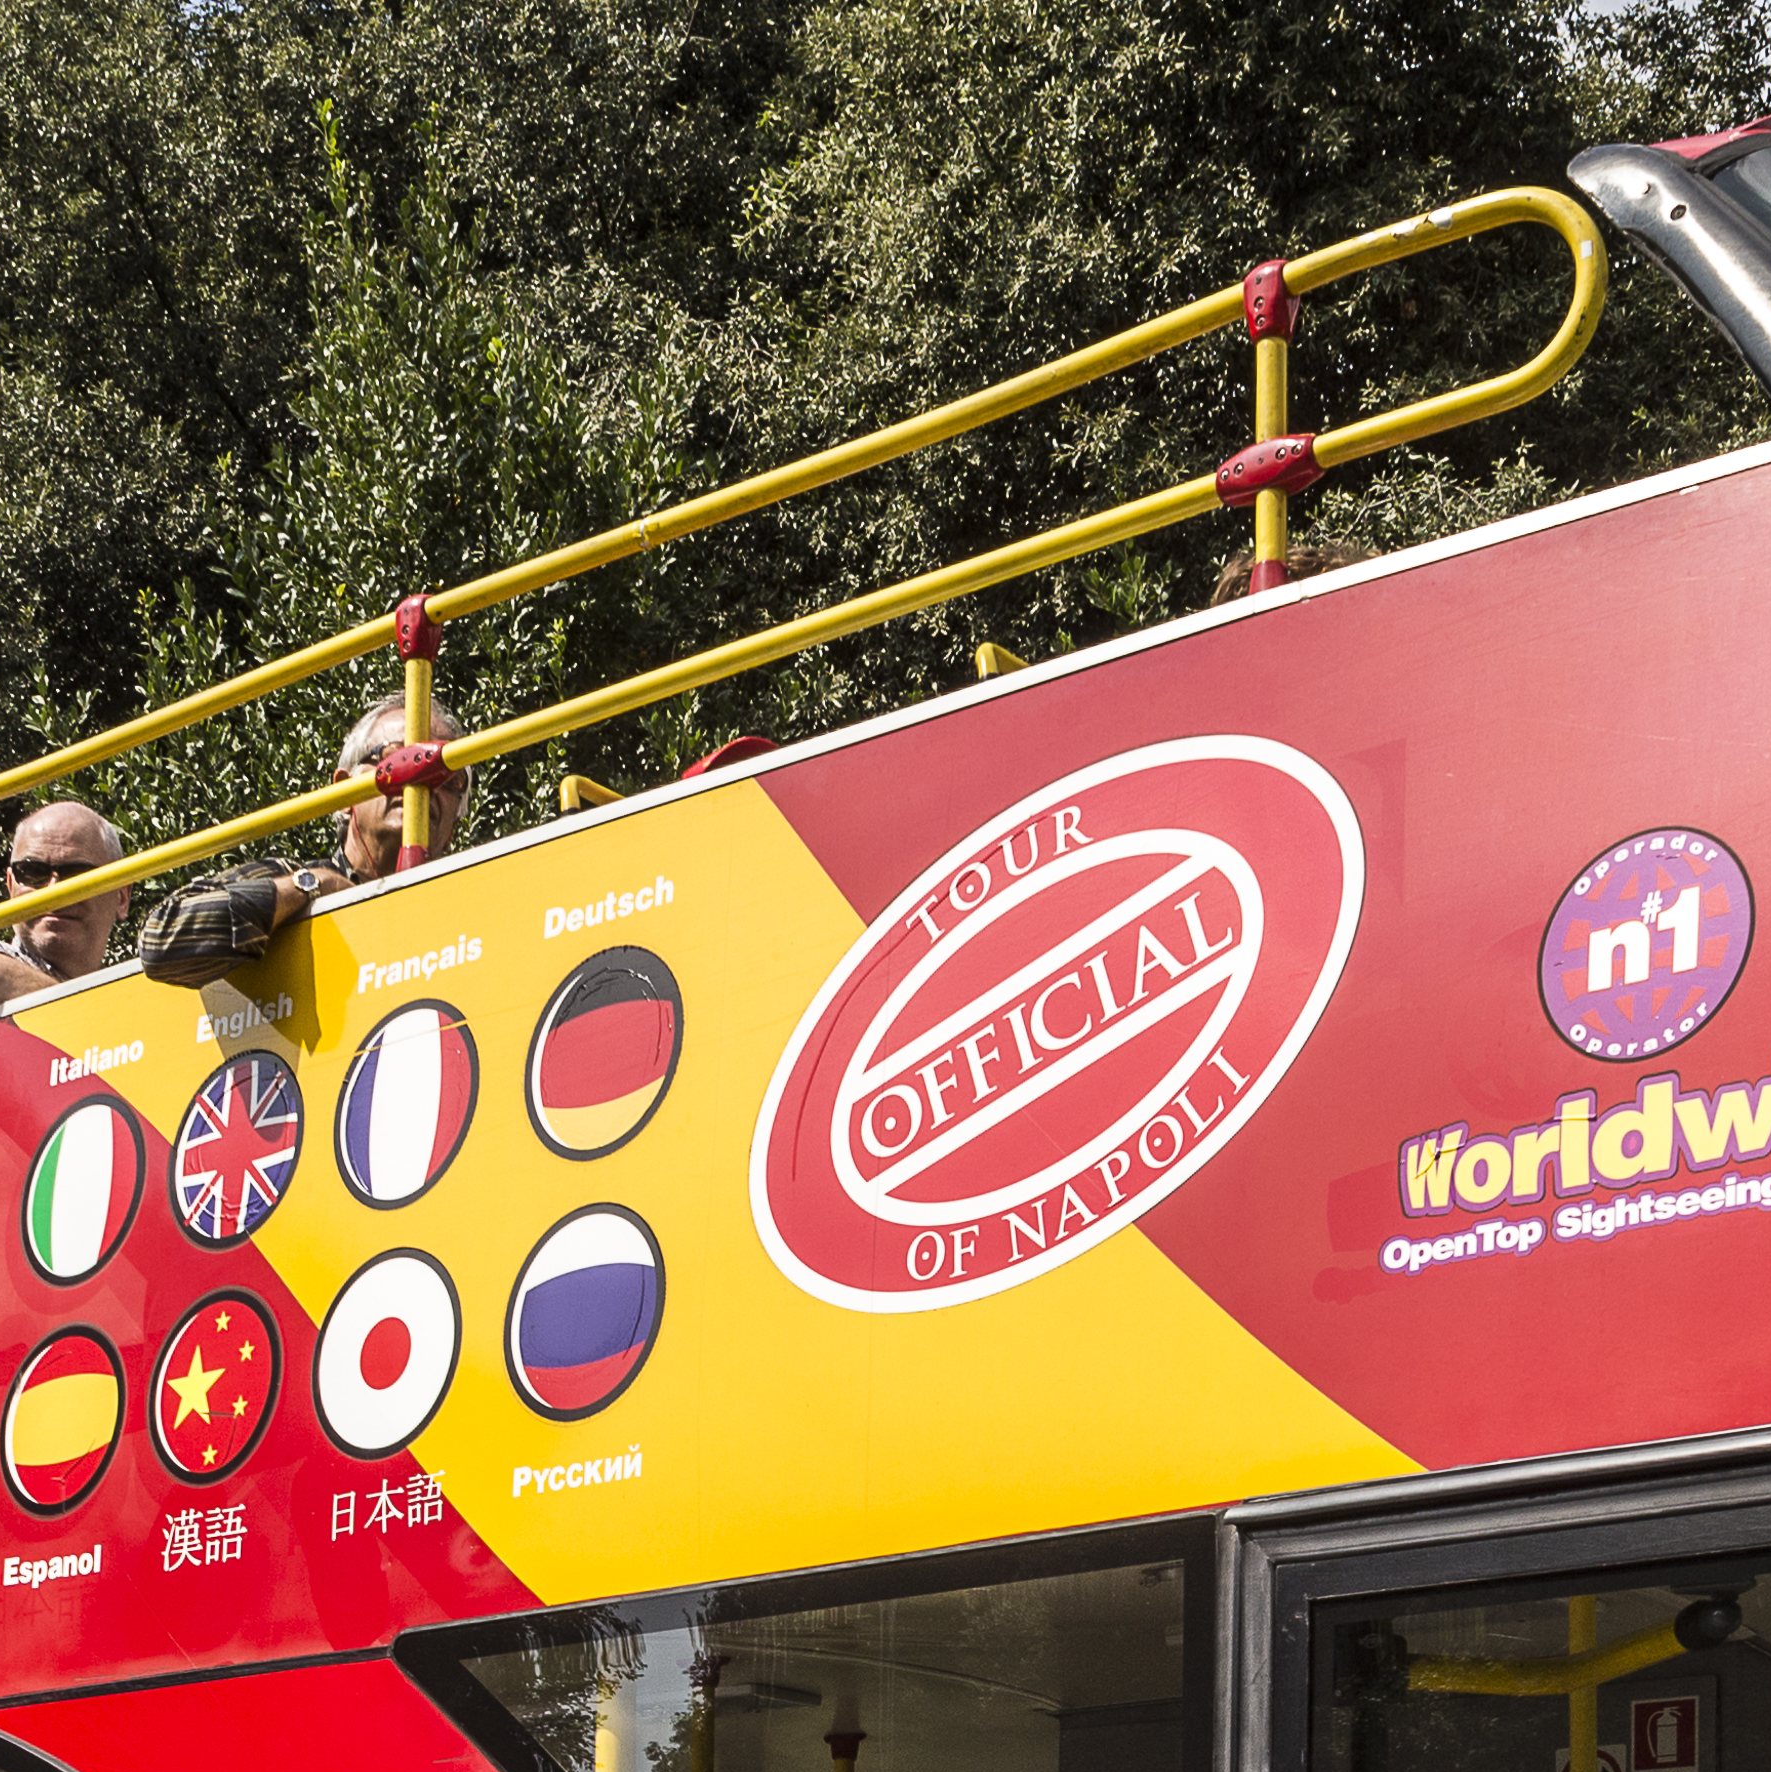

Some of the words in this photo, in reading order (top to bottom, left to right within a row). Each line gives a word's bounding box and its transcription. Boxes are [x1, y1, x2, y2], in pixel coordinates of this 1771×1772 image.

[905, 804, 1094, 945] TOUR
[1573, 833, 1718, 896] Operador
[543, 874, 675, 940] Deutsch
[356, 933, 483, 994] Français
[195, 992, 294, 1044] English
[860, 890, 1233, 1159] OFFICIAL
[1568, 1001, 1708, 1058] Operator
[49, 1036, 145, 1087] Italiano
[905, 1224, 981, 1282] OF
[1001, 1045, 1251, 1263] NAPOLI
[1382, 1217, 1543, 1273] OpenTop
[160, 1503, 248, 1573] 漢語
[330, 1470, 446, 1543] 日本語
[1, 1544, 103, 1590] Espanol
